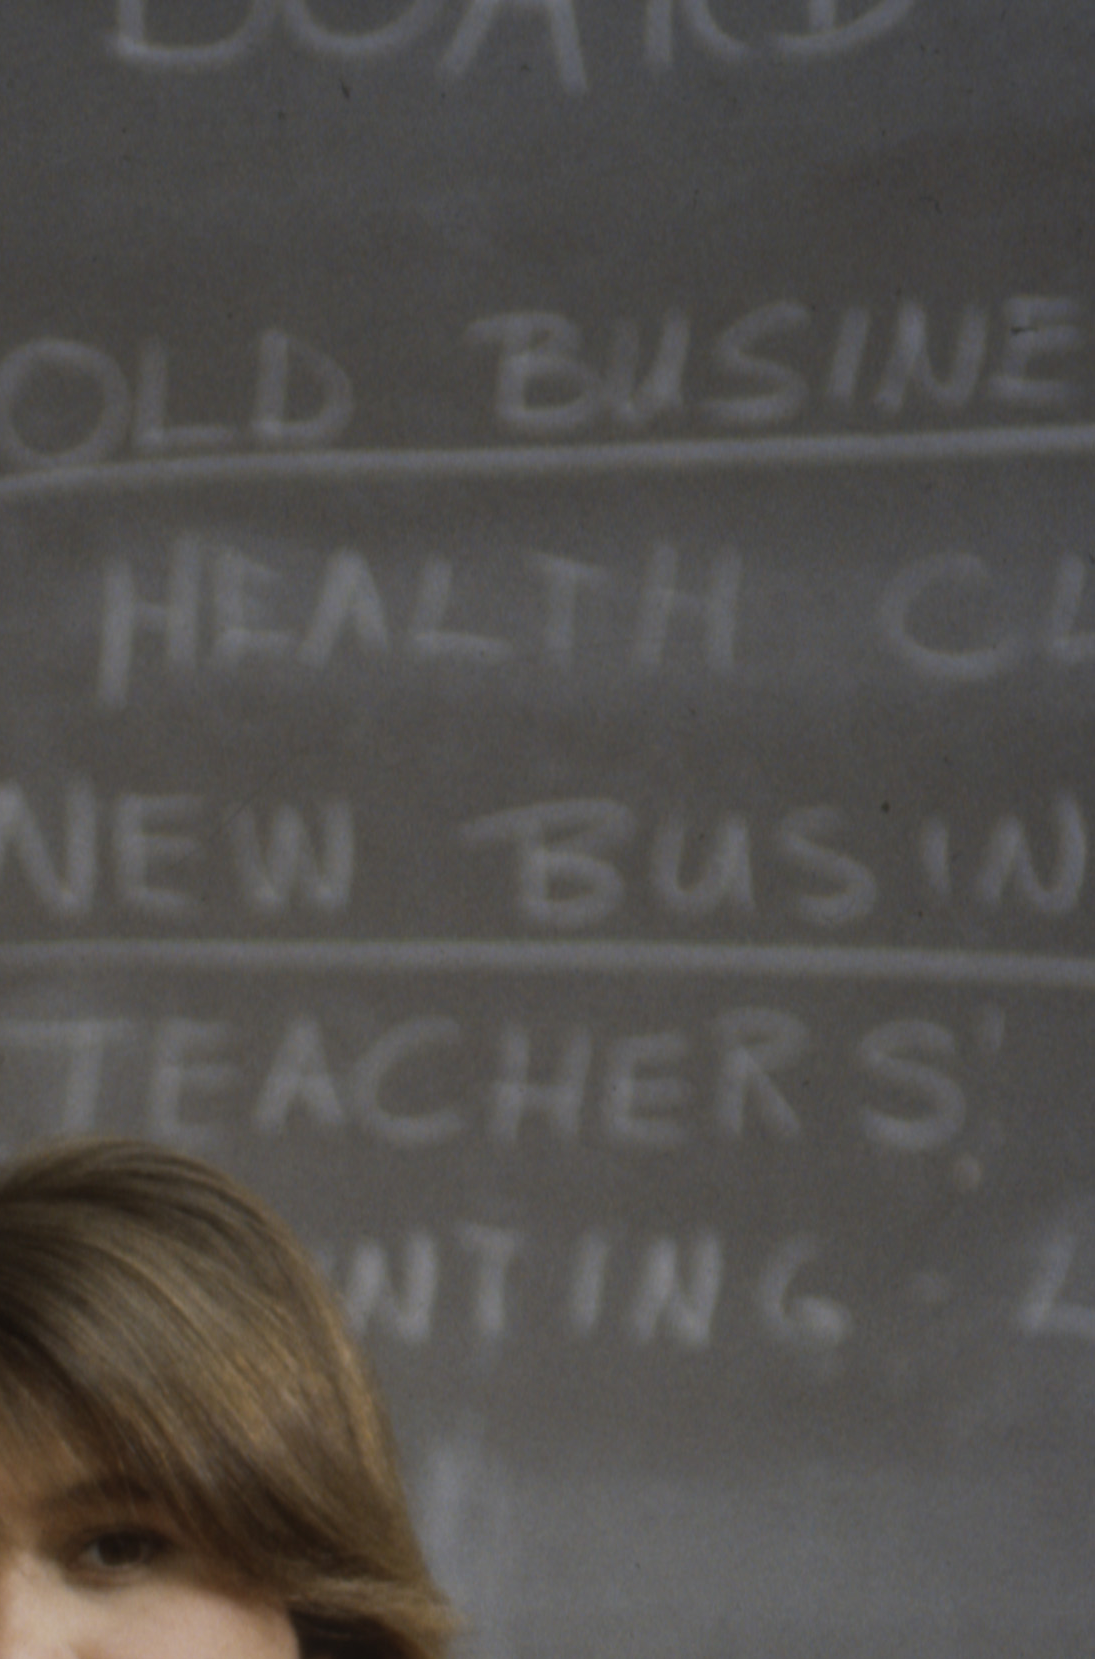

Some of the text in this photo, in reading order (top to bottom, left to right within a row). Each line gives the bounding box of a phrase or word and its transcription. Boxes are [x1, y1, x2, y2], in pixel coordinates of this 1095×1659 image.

[462, 292, 1085, 434] BUSINE
[101, 530, 745, 705] HEALTH
[460, 790, 1089, 928] BUSIN
[310, 1222, 855, 1352] NTING
